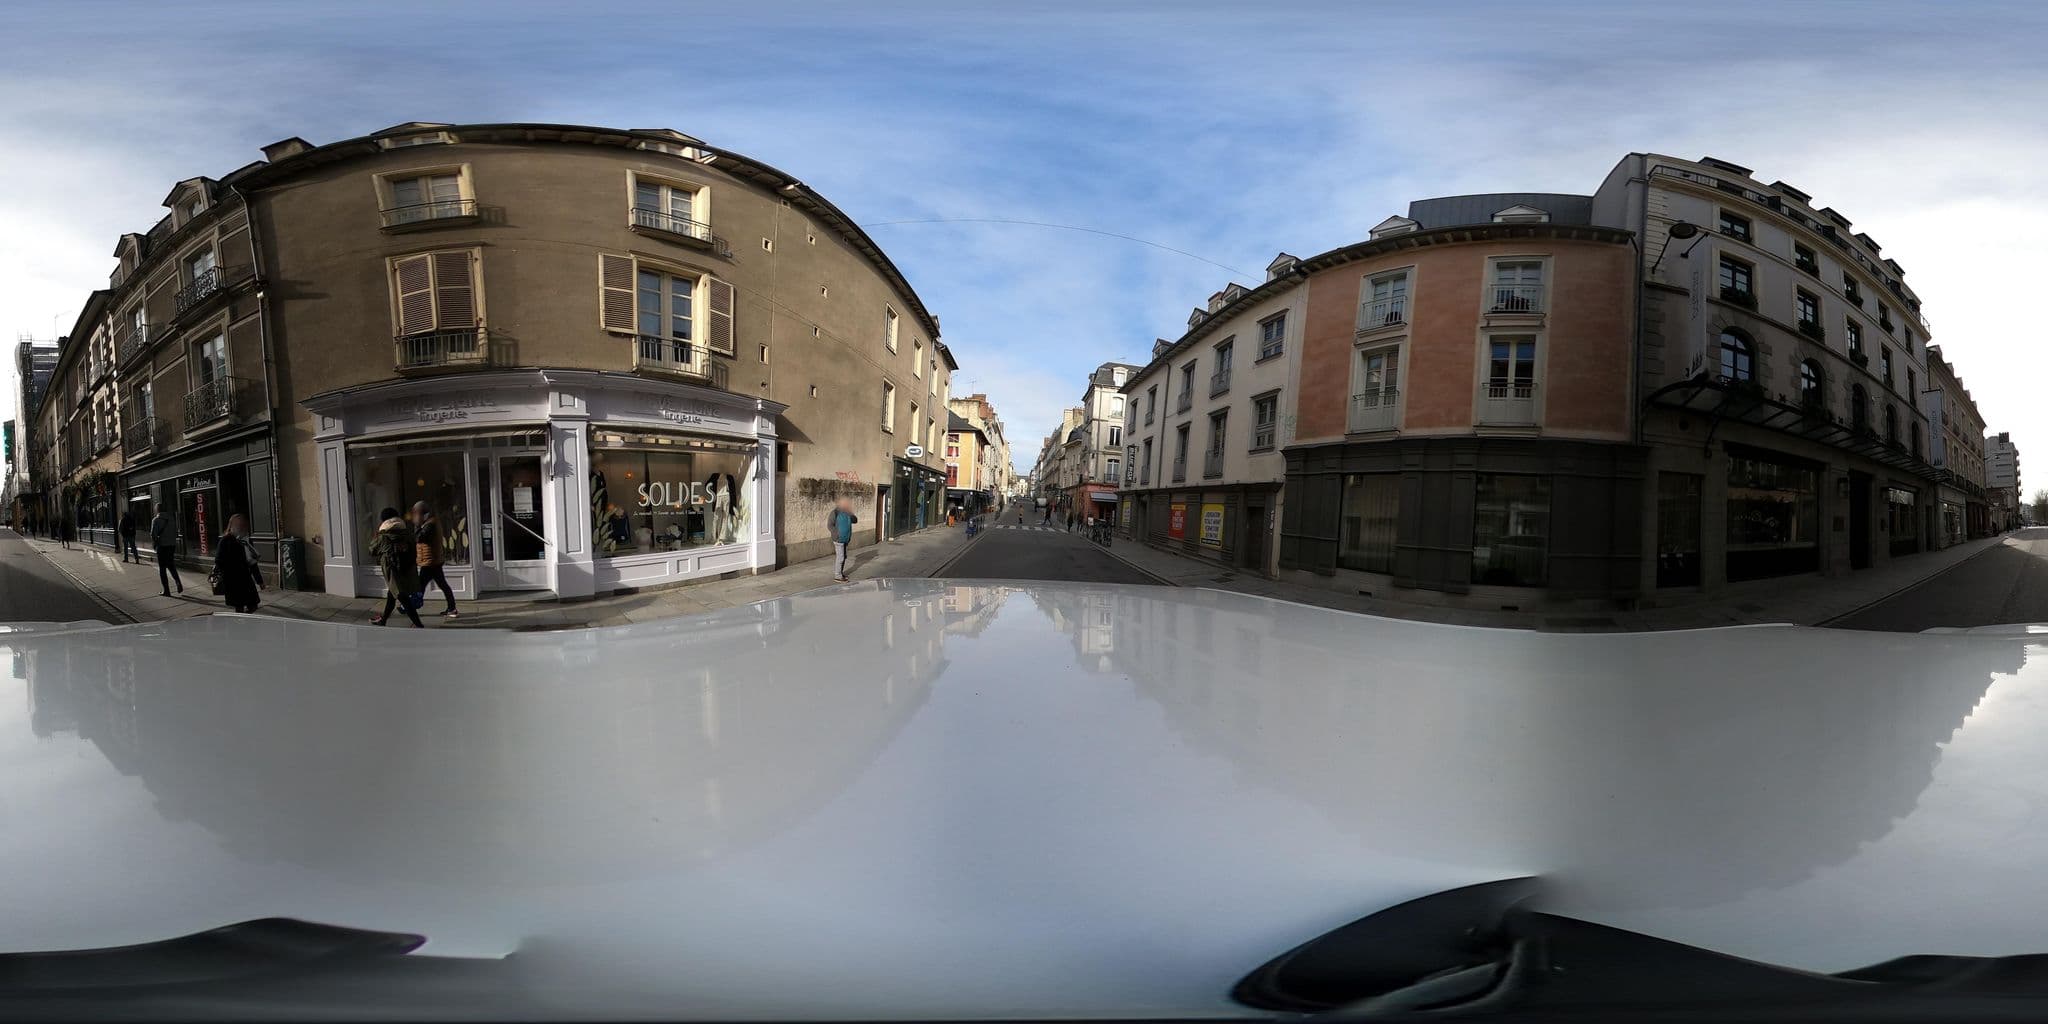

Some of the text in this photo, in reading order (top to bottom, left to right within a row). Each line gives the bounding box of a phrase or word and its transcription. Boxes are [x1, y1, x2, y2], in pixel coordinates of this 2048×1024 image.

[417, 408, 468, 423] lingerie
[662, 410, 702, 425] lingerie
[638, 481, 716, 507] SOLDES
[196, 493, 207, 553] SOLDES
